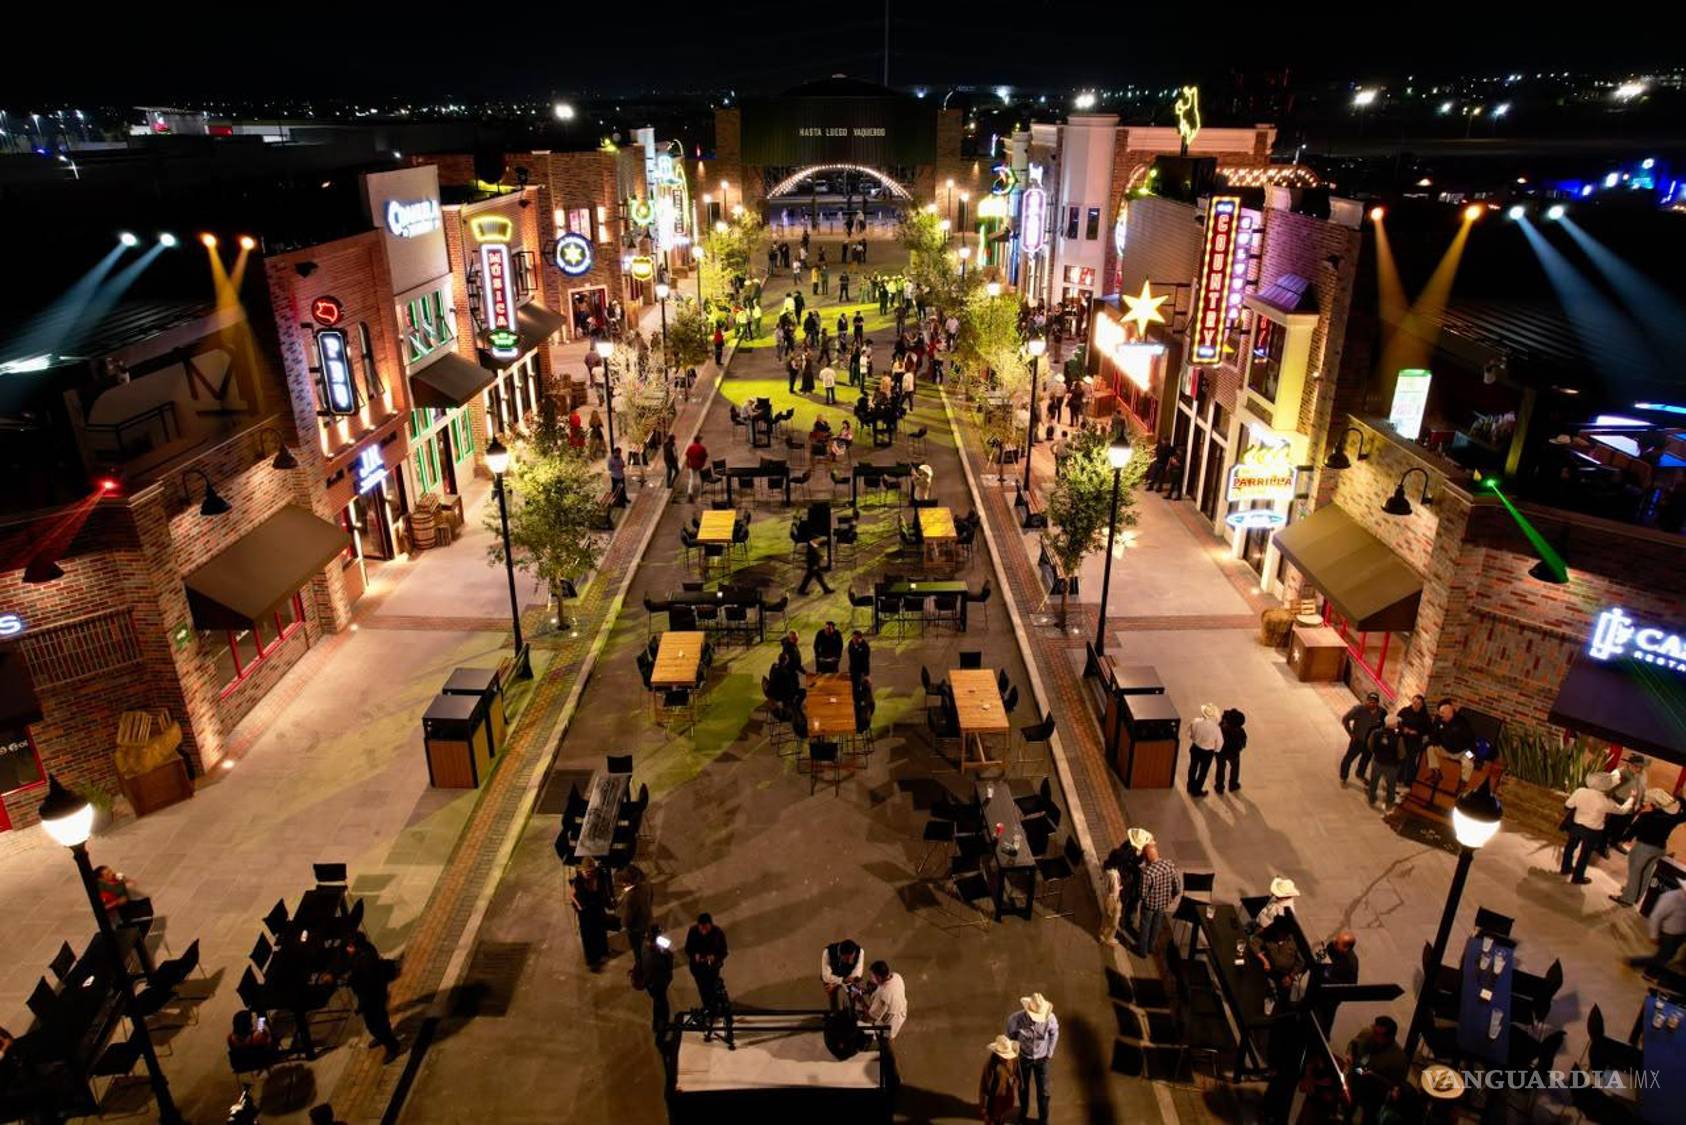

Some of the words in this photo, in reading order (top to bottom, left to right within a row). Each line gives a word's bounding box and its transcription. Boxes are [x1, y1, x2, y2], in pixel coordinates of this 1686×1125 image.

[798, 127, 822, 137] HASTA
[825, 127, 848, 137] LUEGO
[1203, 213, 1230, 347] COUNTRY
[1232, 476, 1293, 487] PARRILLA
[1636, 628, 1686, 662] CA
